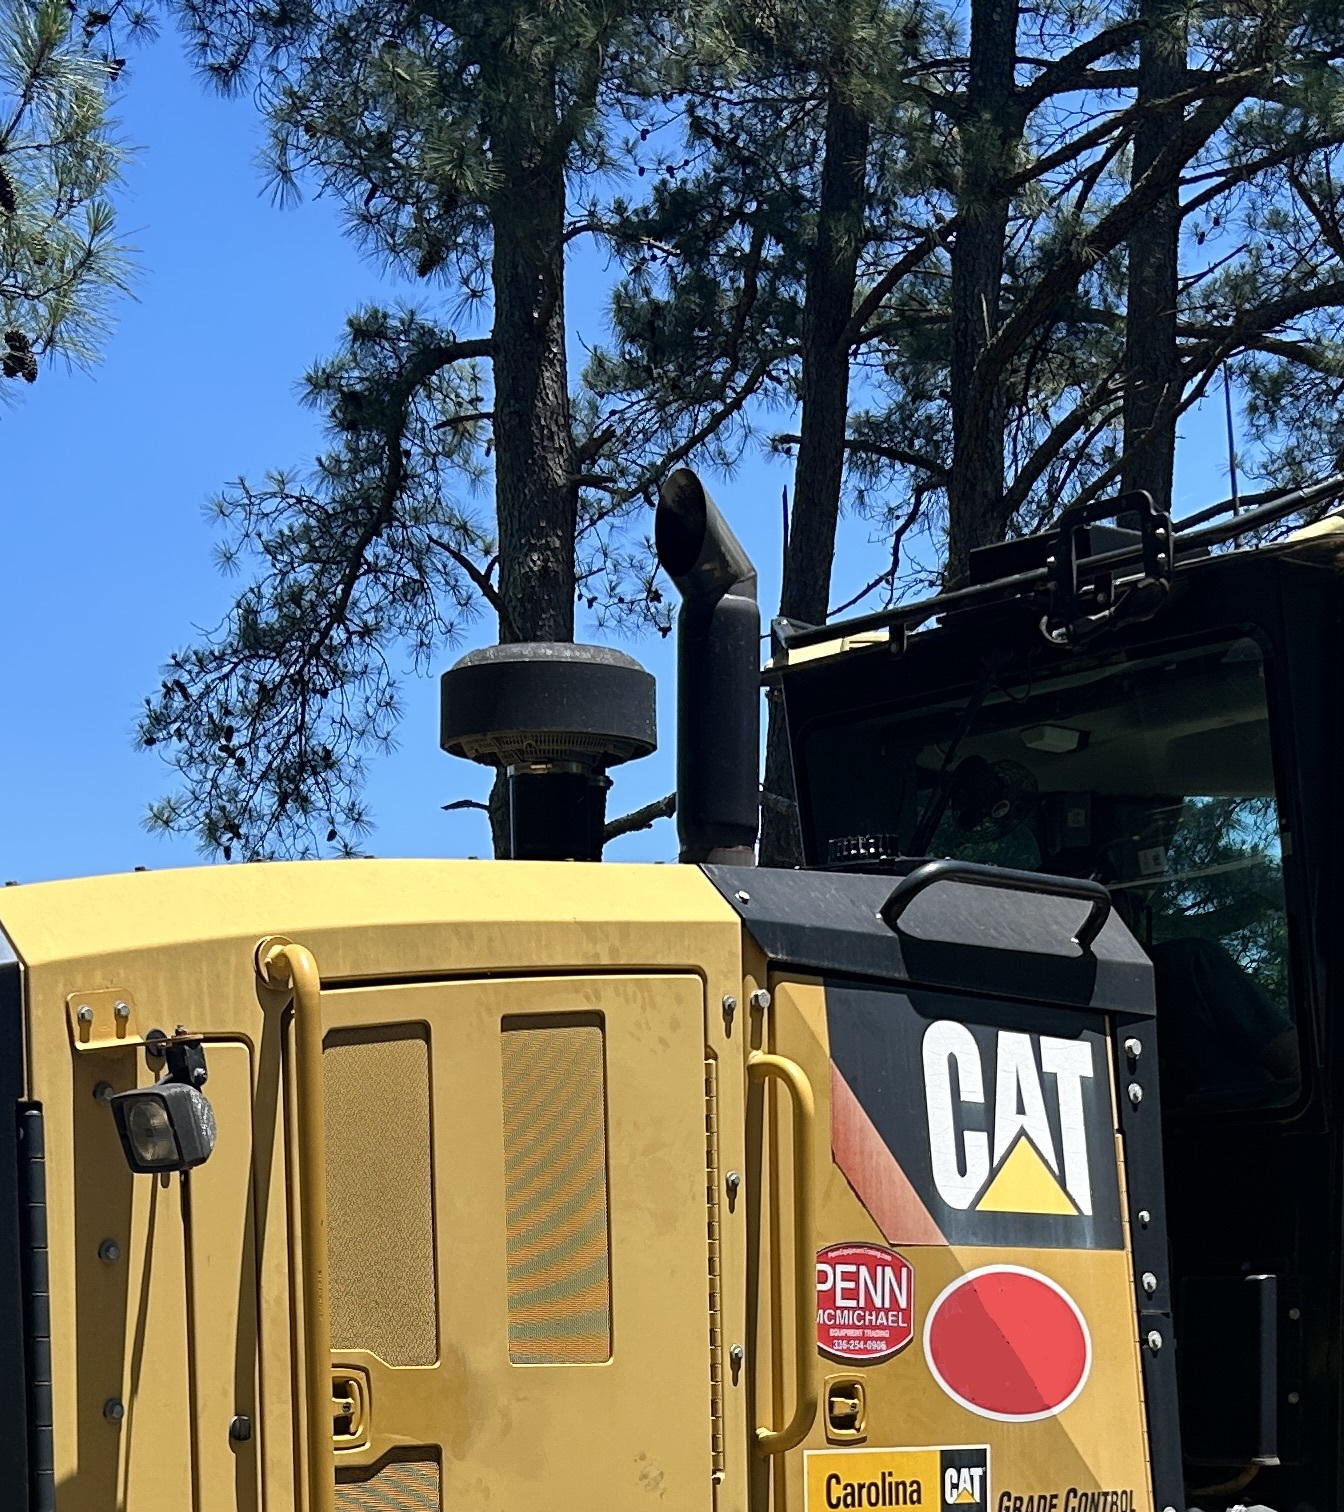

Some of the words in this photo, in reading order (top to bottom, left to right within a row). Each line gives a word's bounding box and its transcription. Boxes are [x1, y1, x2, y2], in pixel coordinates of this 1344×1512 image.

[922, 1020, 1094, 1216] CAT
[816, 1263, 908, 1309] PENN
[816, 1309, 908, 1327] MCMICHAEL
[825, 1471, 922, 1510] Carolina
[944, 1467, 984, 1505] CAT
